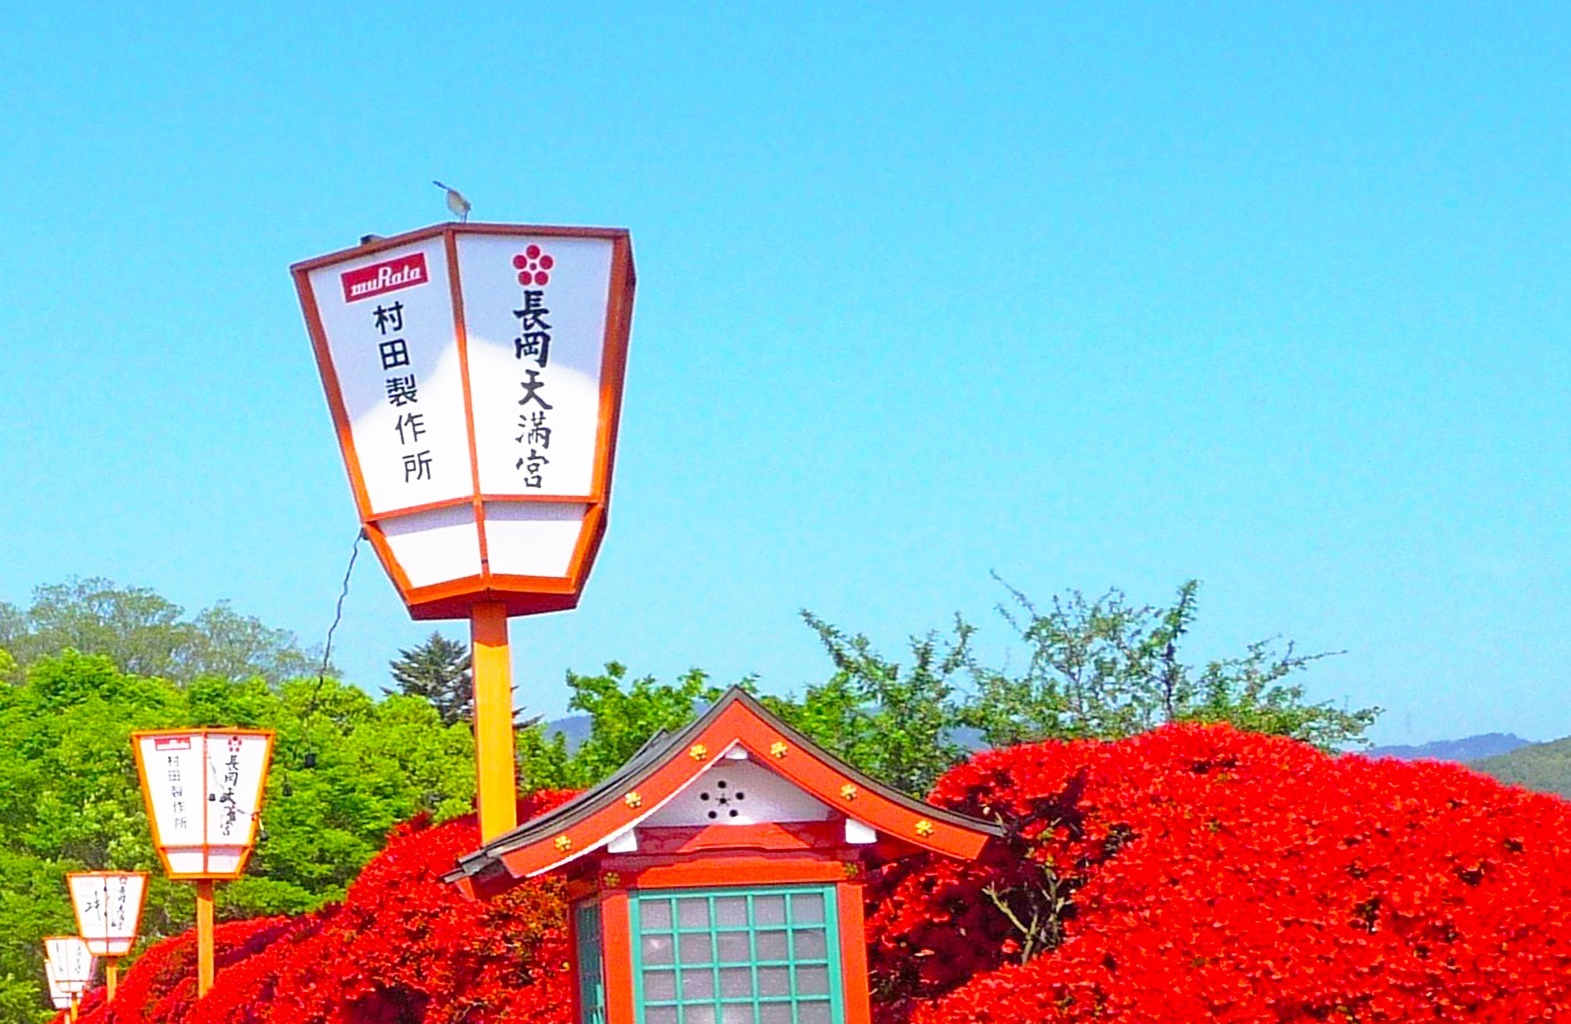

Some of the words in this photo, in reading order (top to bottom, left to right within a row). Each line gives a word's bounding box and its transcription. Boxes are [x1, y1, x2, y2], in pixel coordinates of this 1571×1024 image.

[350, 265, 422, 297] muRata
[373, 301, 433, 483] 村田製作所
[512, 290, 554, 489] 長岡天満宮
